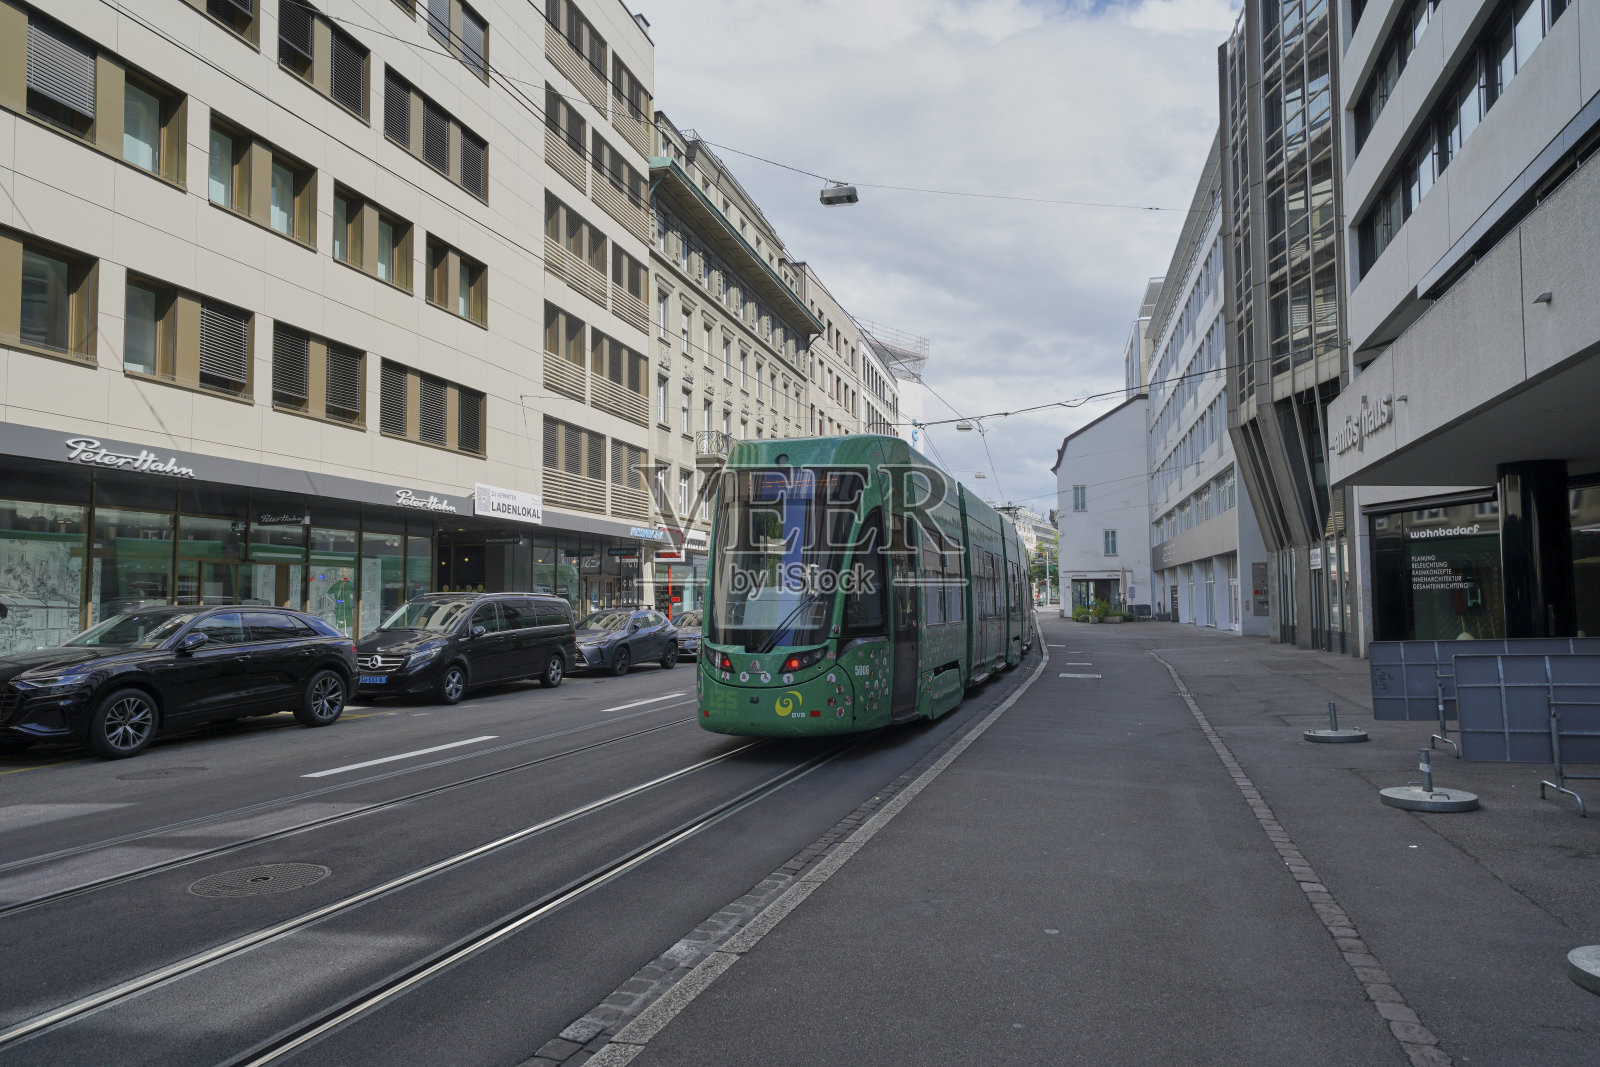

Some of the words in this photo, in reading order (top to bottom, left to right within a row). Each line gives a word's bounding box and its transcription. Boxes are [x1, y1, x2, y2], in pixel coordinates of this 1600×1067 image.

[65, 438, 134, 468] Peter
[131, 449, 195, 478] Hahn
[396, 489, 428, 508] Peter
[426, 495, 457, 513] Hahn
[491, 500, 541, 519] LADENLOKAL
[1411, 568, 1452, 576] RAUMKONZEPTE
[1411, 575, 1462, 583] INNENARCHITEKTUR
[1412, 582, 1470, 590] GESAMTEINRICHTUNG
